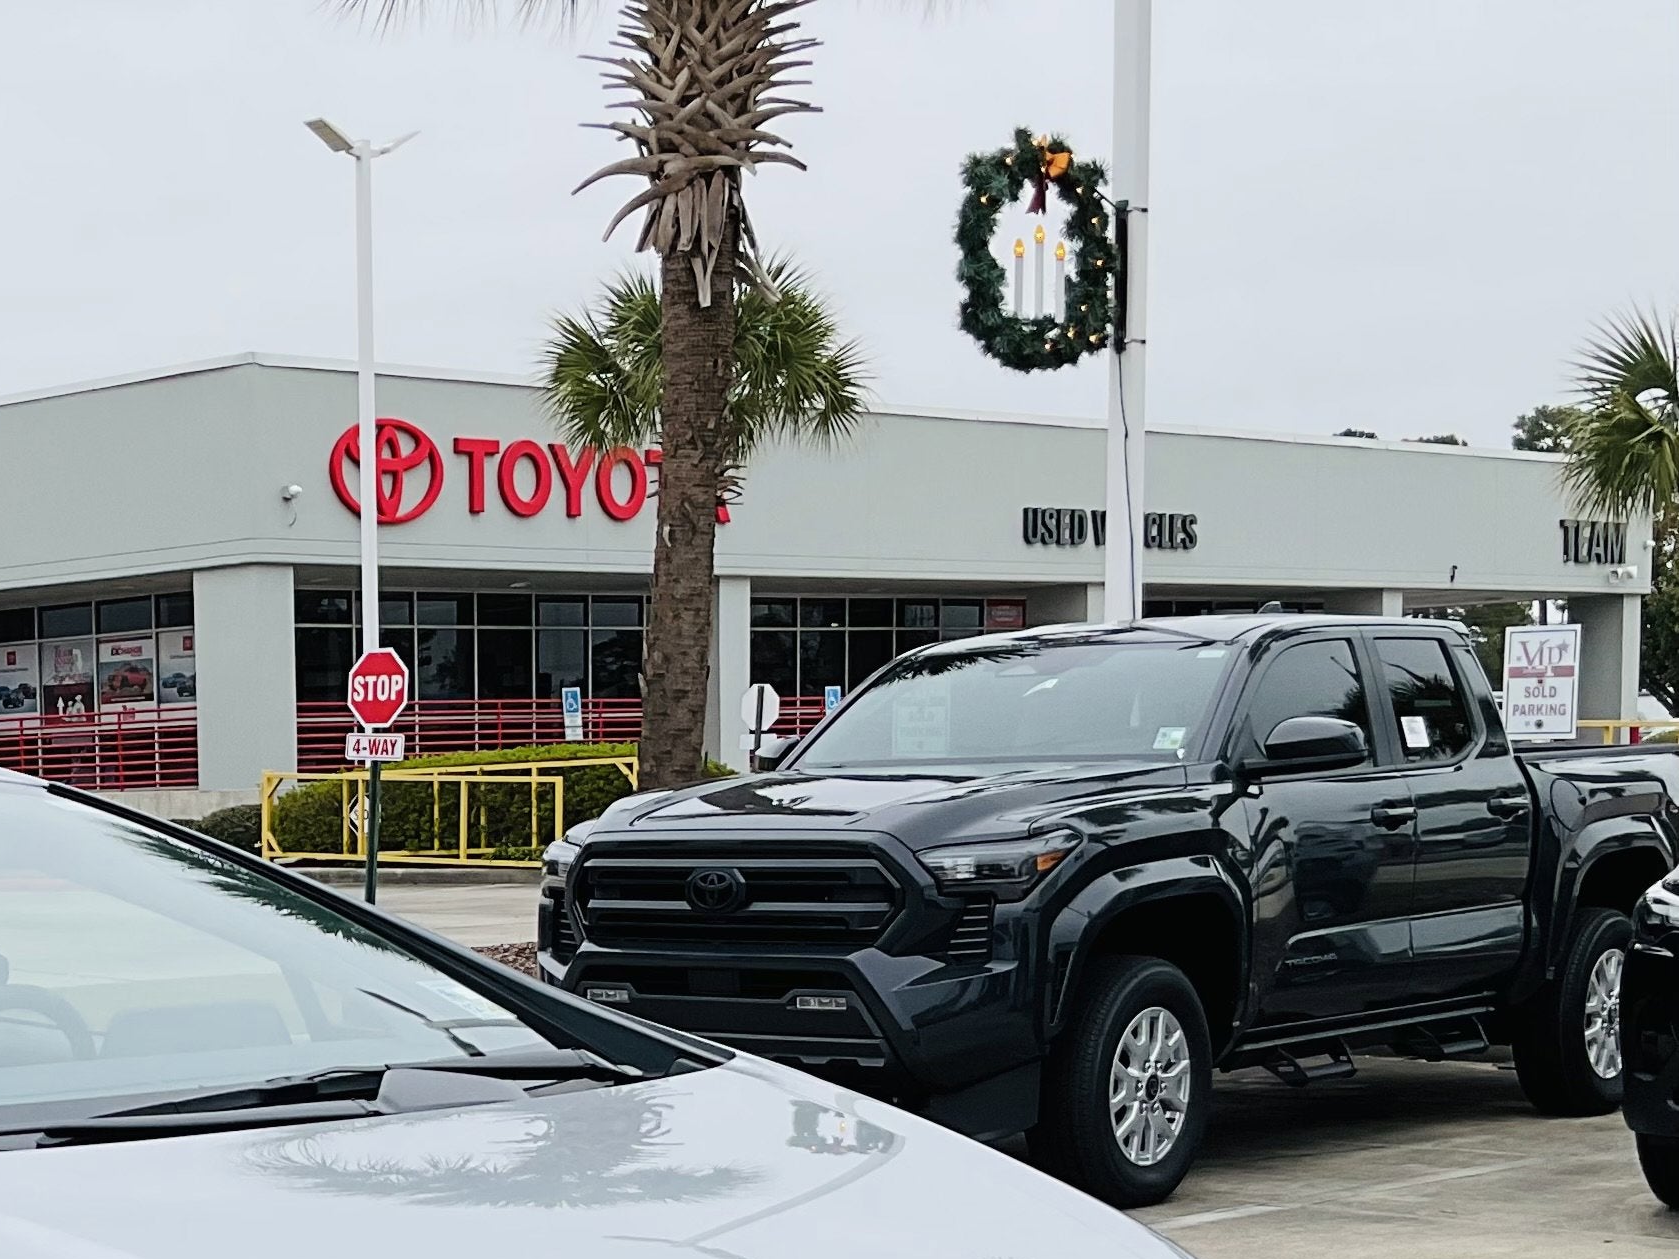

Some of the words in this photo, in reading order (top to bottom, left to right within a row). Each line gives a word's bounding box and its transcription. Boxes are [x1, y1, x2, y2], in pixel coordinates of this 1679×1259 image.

[453, 437, 730, 524] TOYO
[1023, 507, 1088, 545] USED
[1091, 510, 1197, 549] VCLES
[1559, 519, 1628, 564] TEAM
[353, 675, 403, 702] STOP
[1524, 686, 1557, 698] SOLD
[1512, 704, 1567, 716] PARKING
[352, 738, 398, 756] 4-WAY
